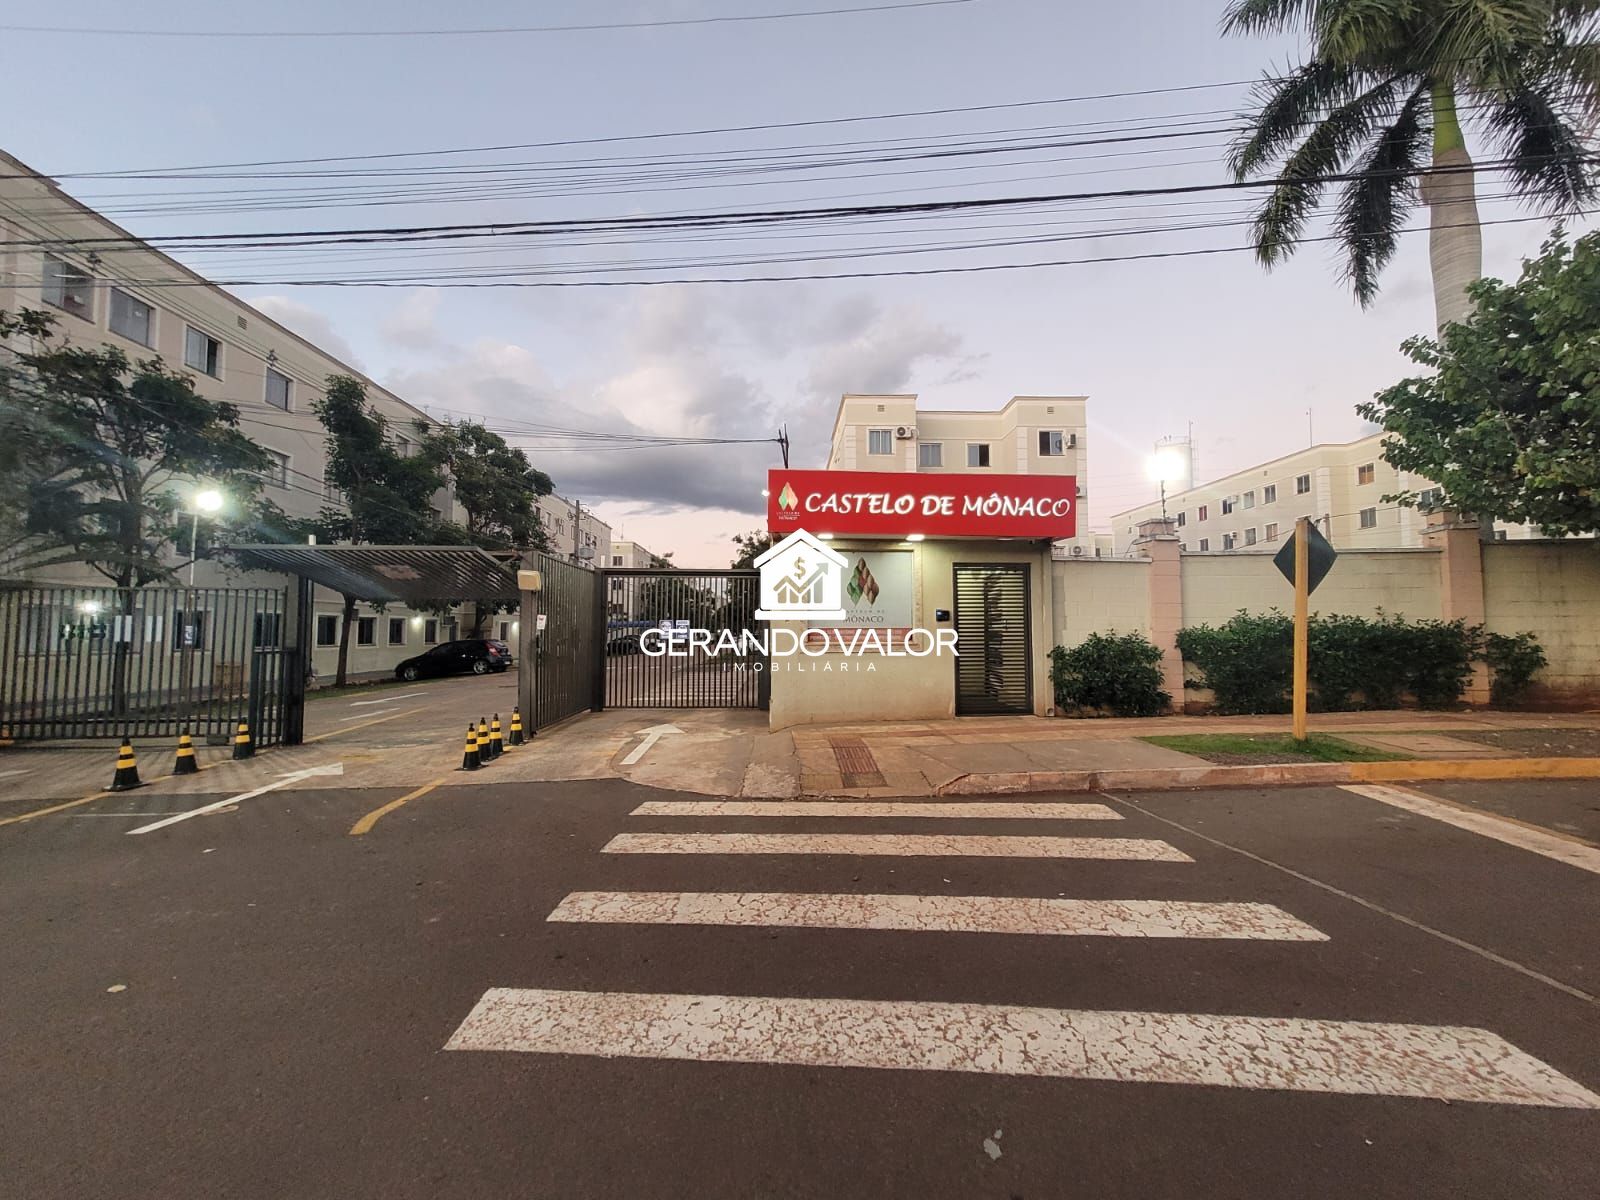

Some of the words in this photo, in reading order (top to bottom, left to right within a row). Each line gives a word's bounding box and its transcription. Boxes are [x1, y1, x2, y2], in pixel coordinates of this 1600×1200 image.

[804, 492, 916, 515] CASTELO
[920, 494, 956, 516] DE
[962, 492, 1071, 517] MÔNACO
